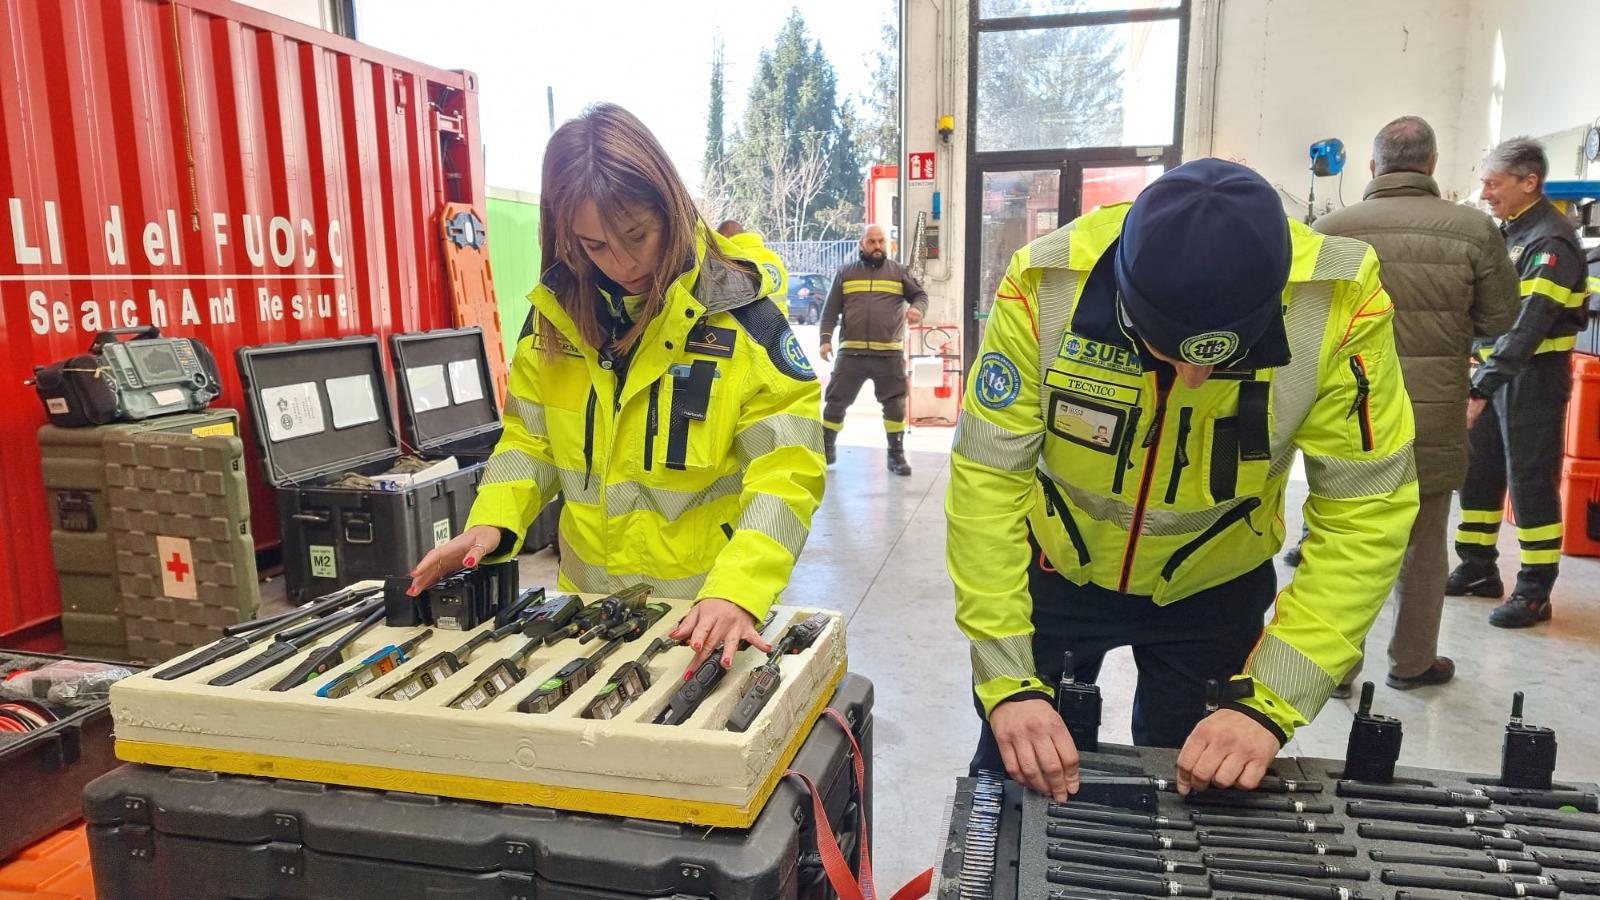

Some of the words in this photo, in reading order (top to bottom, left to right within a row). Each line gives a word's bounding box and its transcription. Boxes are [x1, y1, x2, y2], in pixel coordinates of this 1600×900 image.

[8, 197, 63, 265] LI
[104, 204, 181, 266] del
[181, 288, 235, 326] And
[1198, 343, 1223, 354] 118
[1067, 378, 1117, 397] TECNICO
[436, 527, 448, 542] M2
[313, 555, 332, 567] M2
